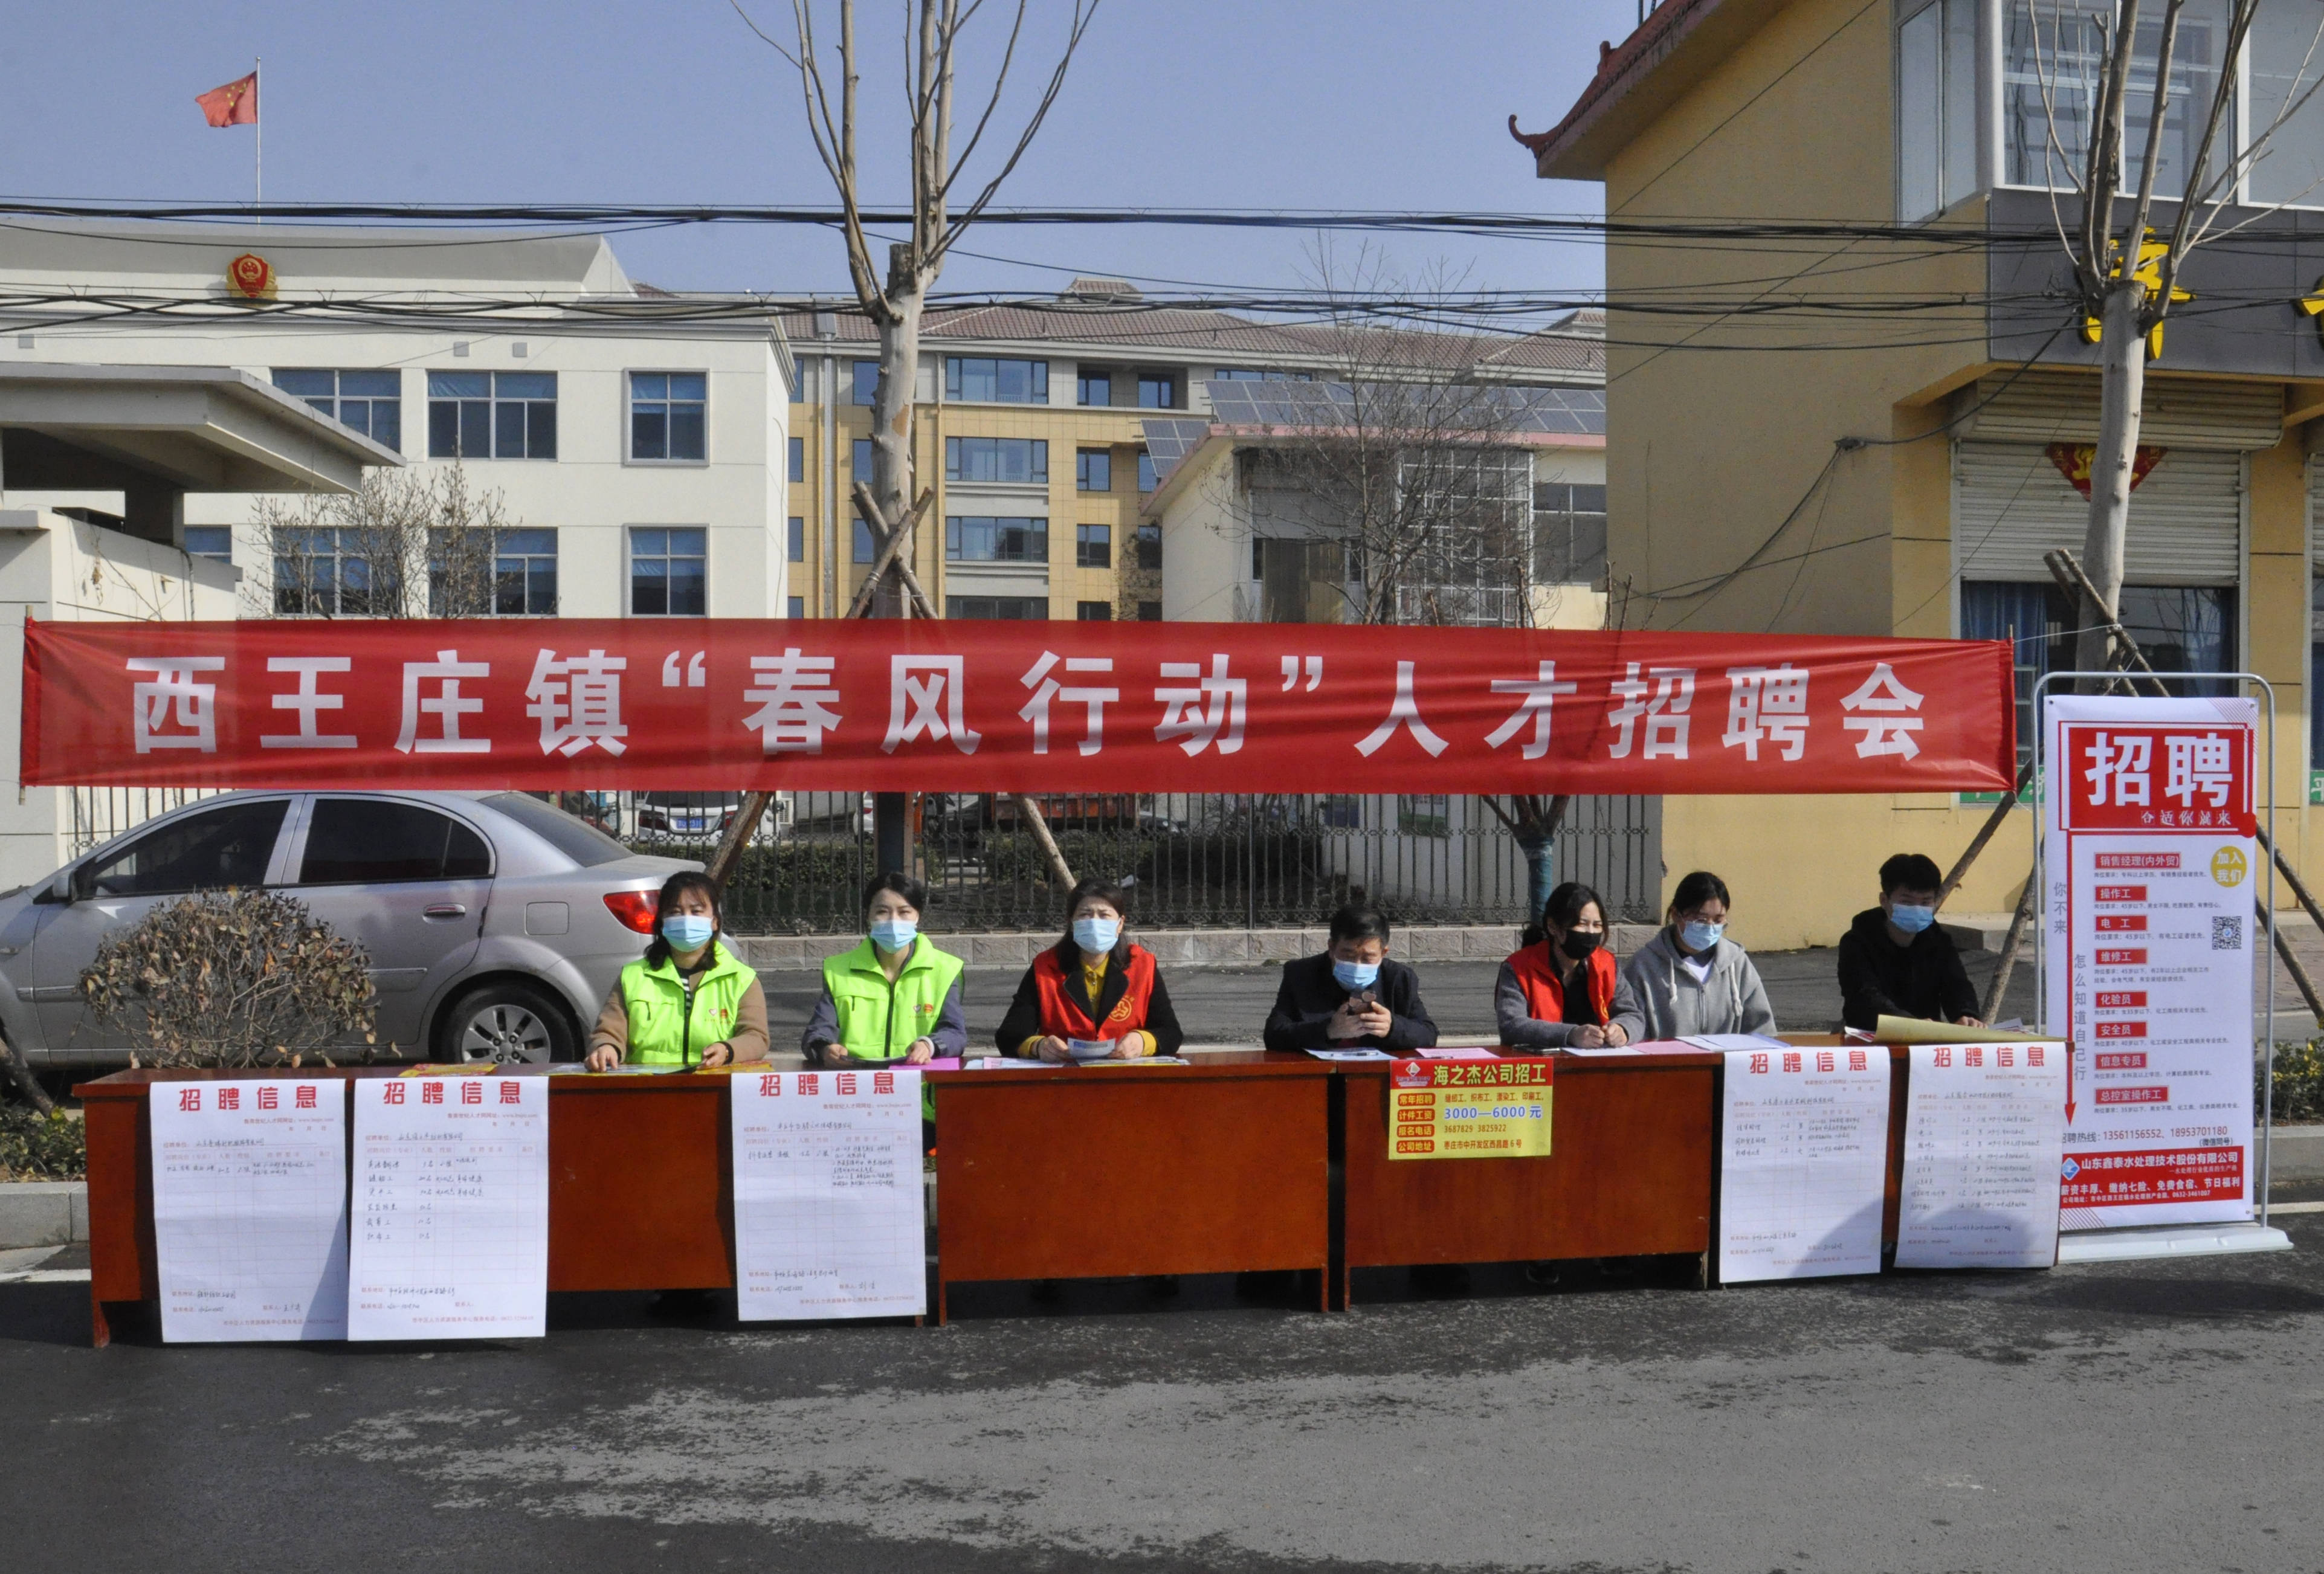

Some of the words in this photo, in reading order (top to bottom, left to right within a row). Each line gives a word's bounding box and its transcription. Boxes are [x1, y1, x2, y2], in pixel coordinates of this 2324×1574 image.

[126, 648, 1925, 761] 西王庄镇“春风行动”人才招聘会
[2084, 732, 2233, 808] 招聘
[2141, 810, 2232, 827] 合适你就来
[2216, 852, 2242, 865] 加入
[2216, 869, 2242, 883] 我们
[2100, 888, 2131, 899] 操作工
[2054, 882, 2067, 934] 你不来
[2101, 951, 2131, 963] 维修工
[2100, 995, 2131, 1005] 化验员
[2074, 954, 2087, 1081] 怎么知道自己行
[2100, 1025, 2131, 1036] 安全员
[1750, 1051, 1867, 1074] 招聘信息
[1934, 1047, 2045, 1068] 招聘信息
[2100, 1055, 2141, 1067] 信息专员
[1434, 1063, 1546, 1086] 海之杰公司招工
[760, 1072, 894, 1097] 招聘信息
[179, 1085, 317, 1111] 招聘信息
[384, 1081, 520, 1105] 招聘信息
[1399, 1094, 1433, 1105] 常年招聘
[2100, 1090, 2162, 1102] 总控室操作工
[1399, 1110, 1433, 1121] 计件工资
[1529, 1106, 1542, 1118] 元
[1398, 1126, 1432, 1136] 报名电话
[1398, 1141, 1432, 1152] 公司地址
[2082, 1152, 2238, 1170] 山东鑫泰水处理技术股份有限公司
